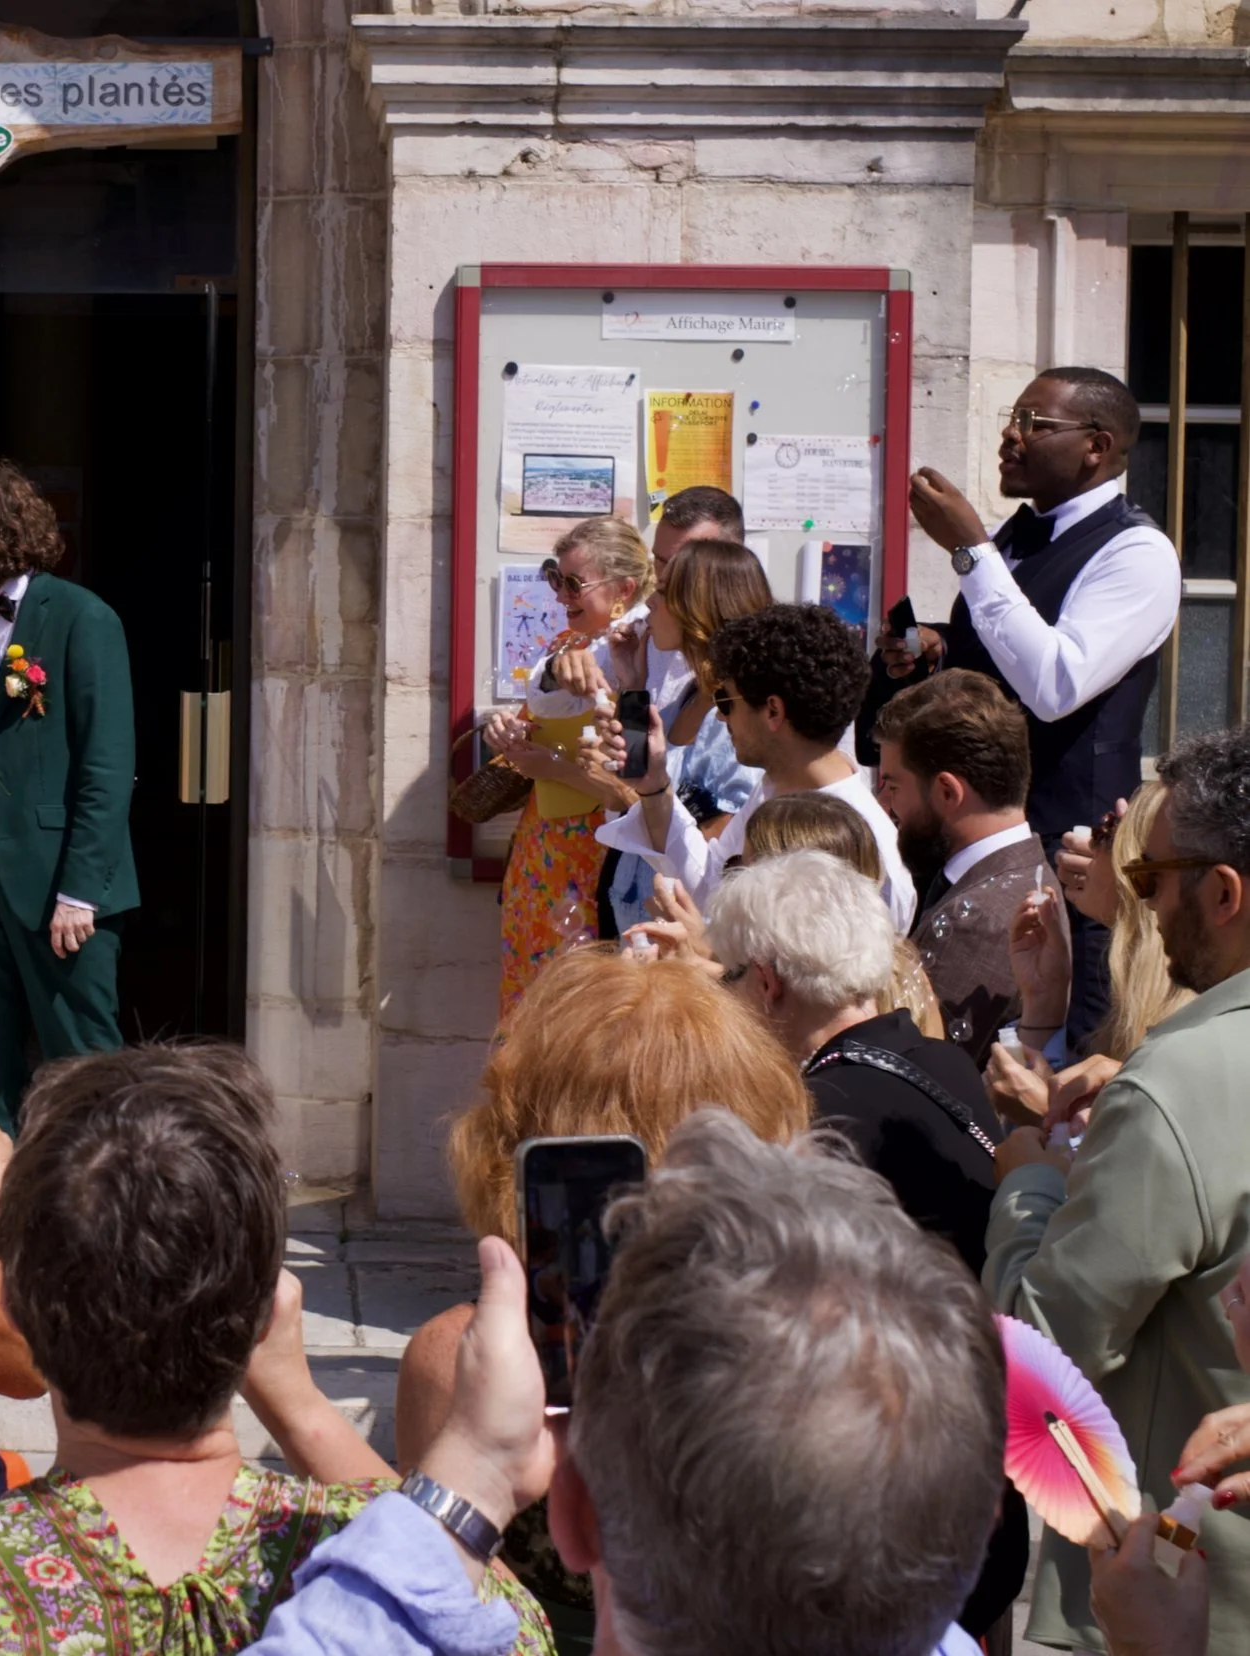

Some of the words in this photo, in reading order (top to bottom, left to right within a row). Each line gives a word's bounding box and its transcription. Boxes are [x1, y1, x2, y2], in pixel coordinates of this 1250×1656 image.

[62, 74, 207, 114] plantés
[665, 315, 735, 334] Affichage
[737, 316, 786, 331] Mairie
[648, 396, 732, 409] INFORMATION
[523, 574, 533, 582] DE
